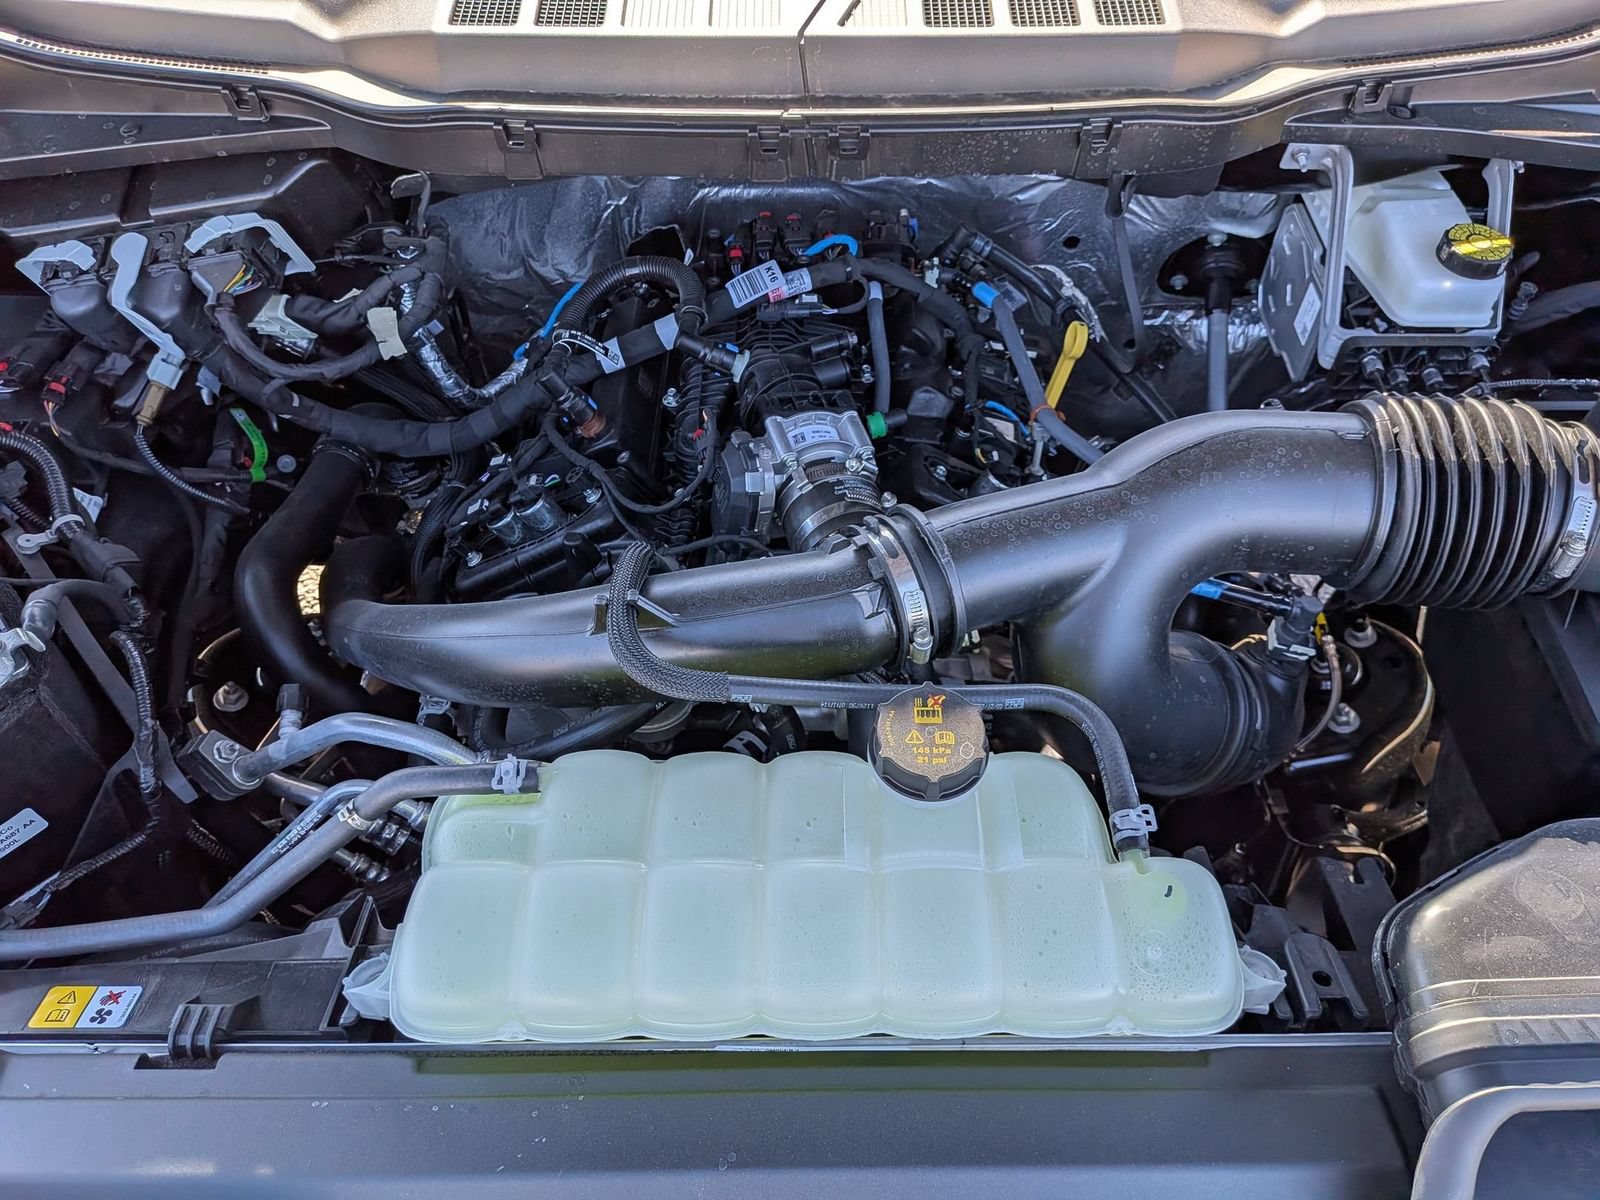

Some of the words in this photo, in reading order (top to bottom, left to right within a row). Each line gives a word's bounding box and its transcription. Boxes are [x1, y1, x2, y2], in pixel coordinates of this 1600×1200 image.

[765, 266, 779, 283] K16
[912, 746, 930, 754] 145
[933, 746, 952, 754] kPa
[932, 756, 947, 765] psi
[23, 819, 37, 829] AA
[0, 825, 14, 837] Co
